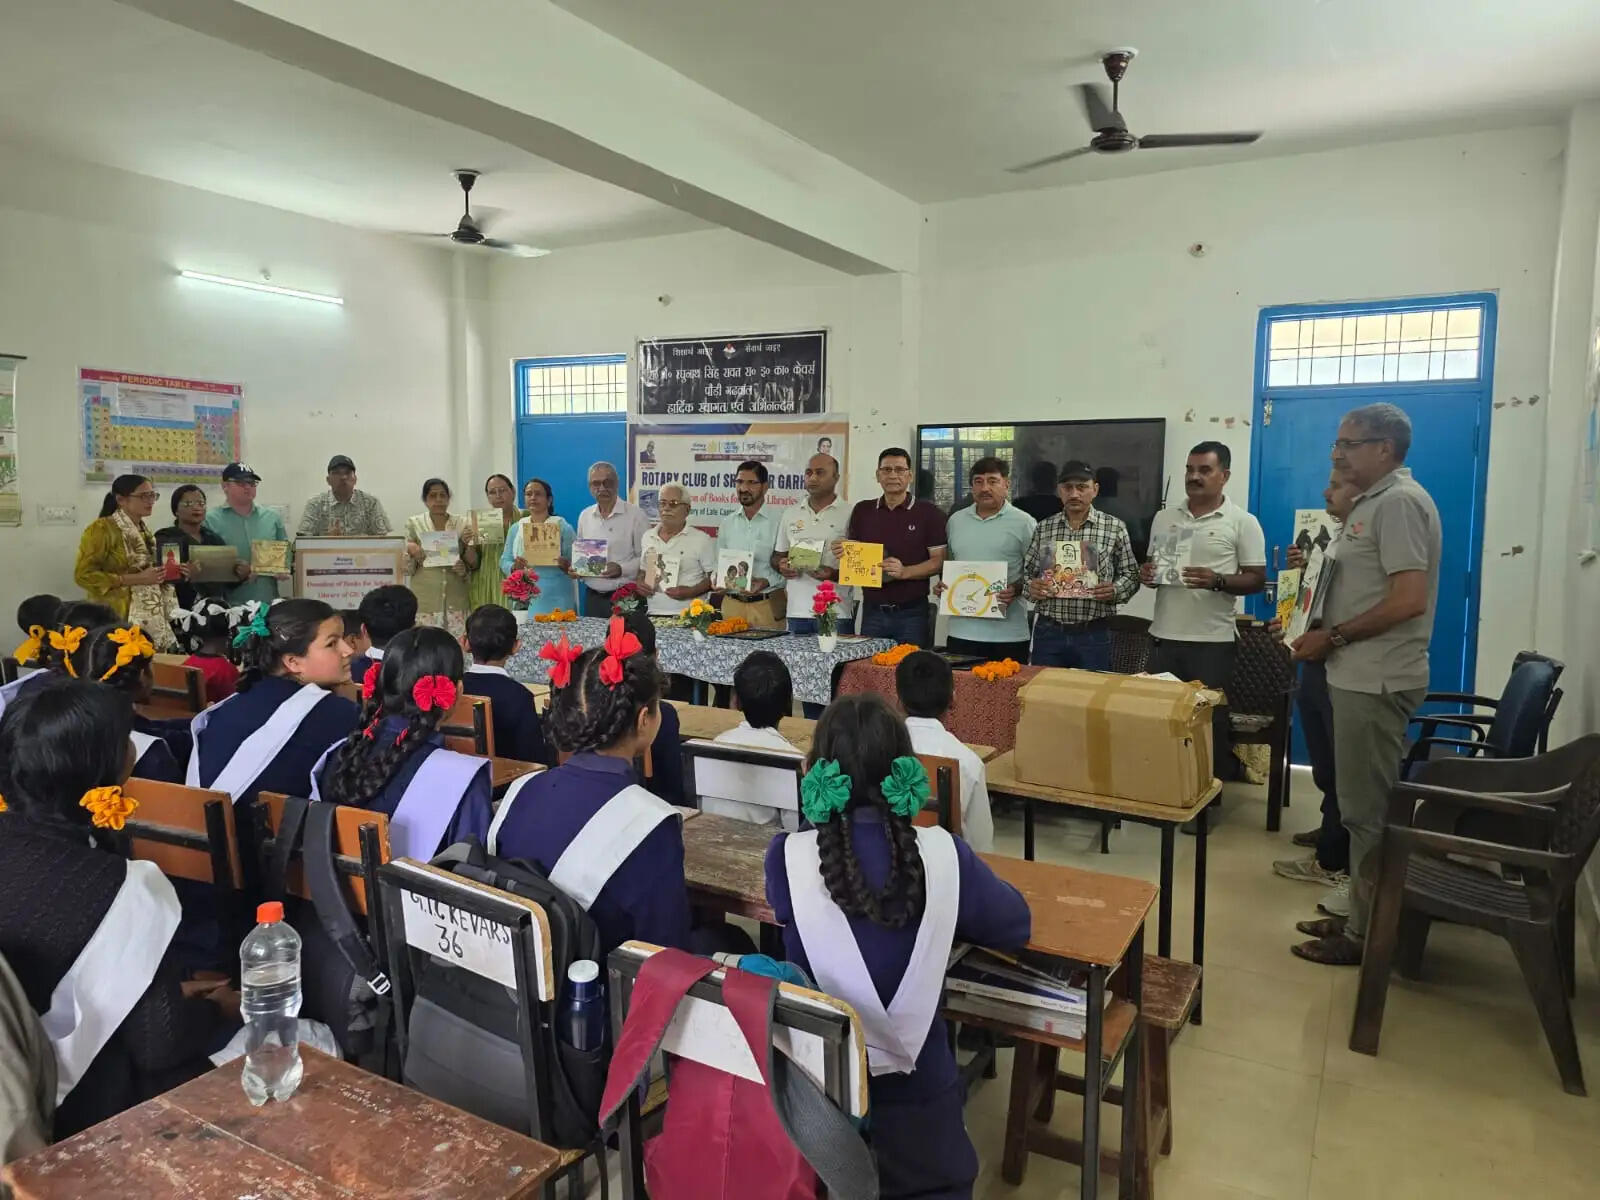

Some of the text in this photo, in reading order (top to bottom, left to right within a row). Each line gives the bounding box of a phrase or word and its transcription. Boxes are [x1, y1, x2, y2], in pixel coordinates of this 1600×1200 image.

[704, 364, 720, 379] सिंह
[723, 367, 741, 378] रावत
[121, 375, 164, 387] PERIODIC
[165, 380, 191, 390] TABLE
[666, 398, 694, 415] हार्दिक
[698, 401, 727, 413] स्वागत
[731, 399, 744, 413] एवं
[641, 472, 680, 487] ROTARY
[681, 473, 708, 488] CLUB
[709, 474, 721, 488] of
[778, 474, 807, 490] GARH
[434, 923, 464, 959] 36
